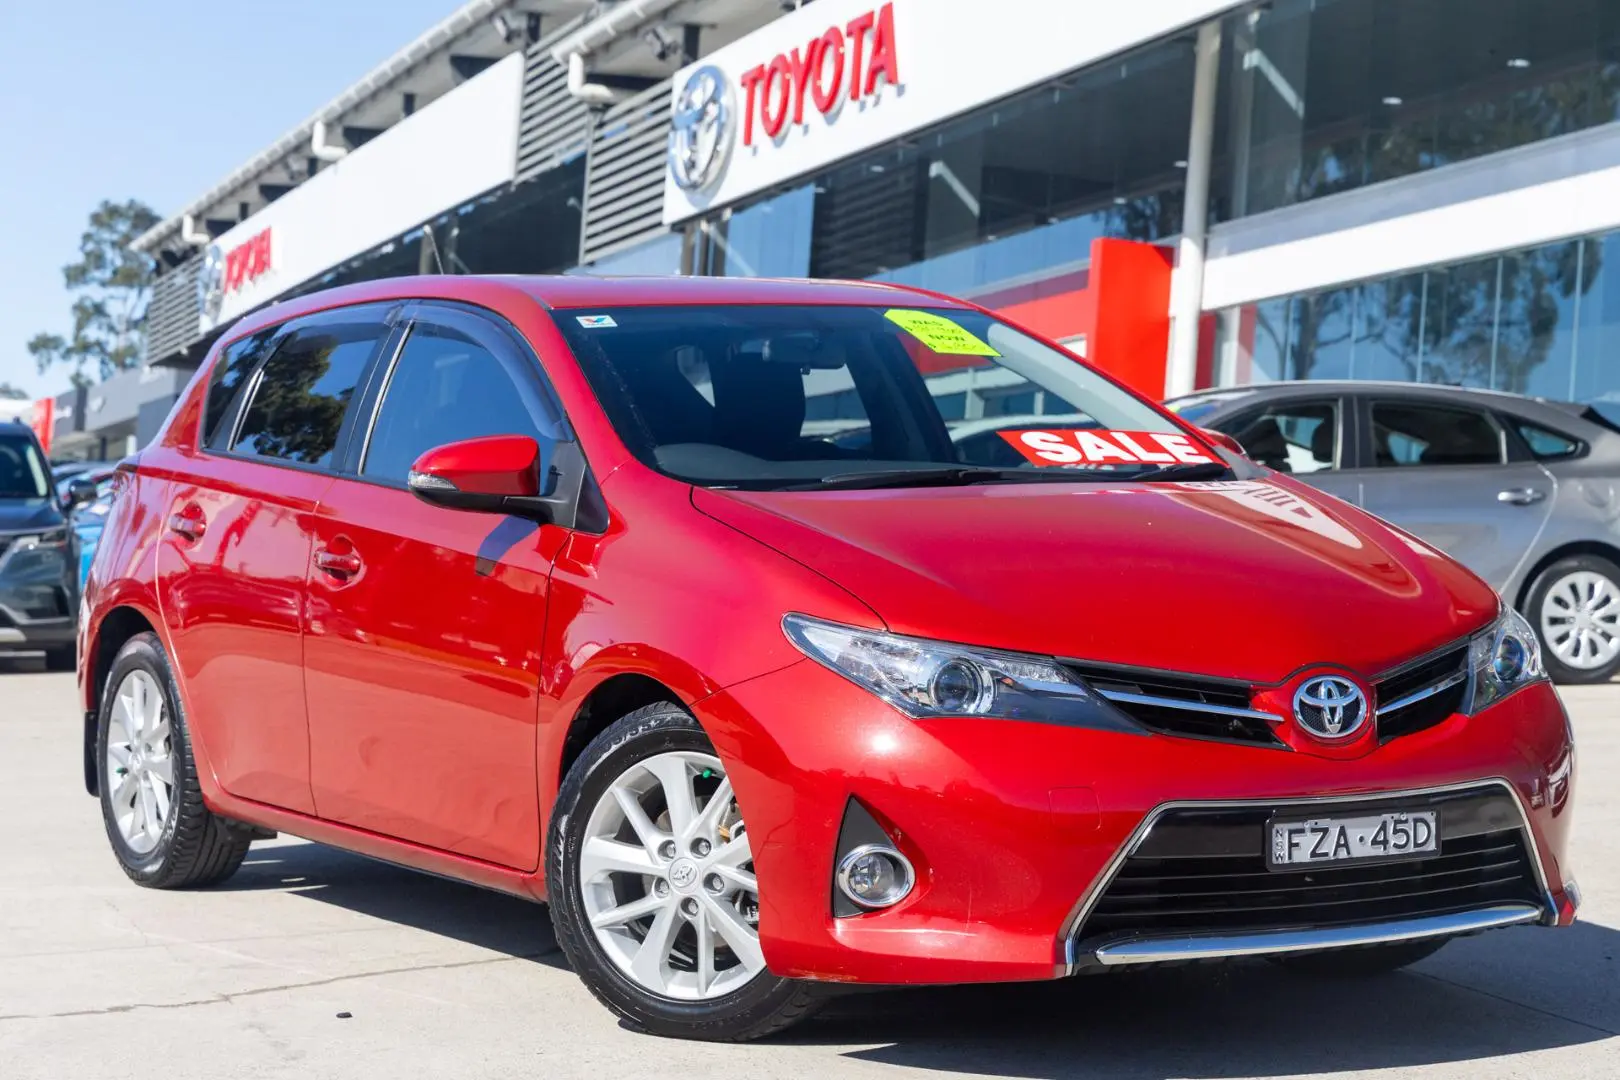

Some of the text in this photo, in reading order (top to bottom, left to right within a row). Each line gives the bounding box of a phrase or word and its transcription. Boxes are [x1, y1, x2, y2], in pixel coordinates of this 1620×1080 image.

[741, 2, 898, 146] TOYOTA
[928, 334, 965, 342] NOW
[1020, 431, 1213, 464] SALE
